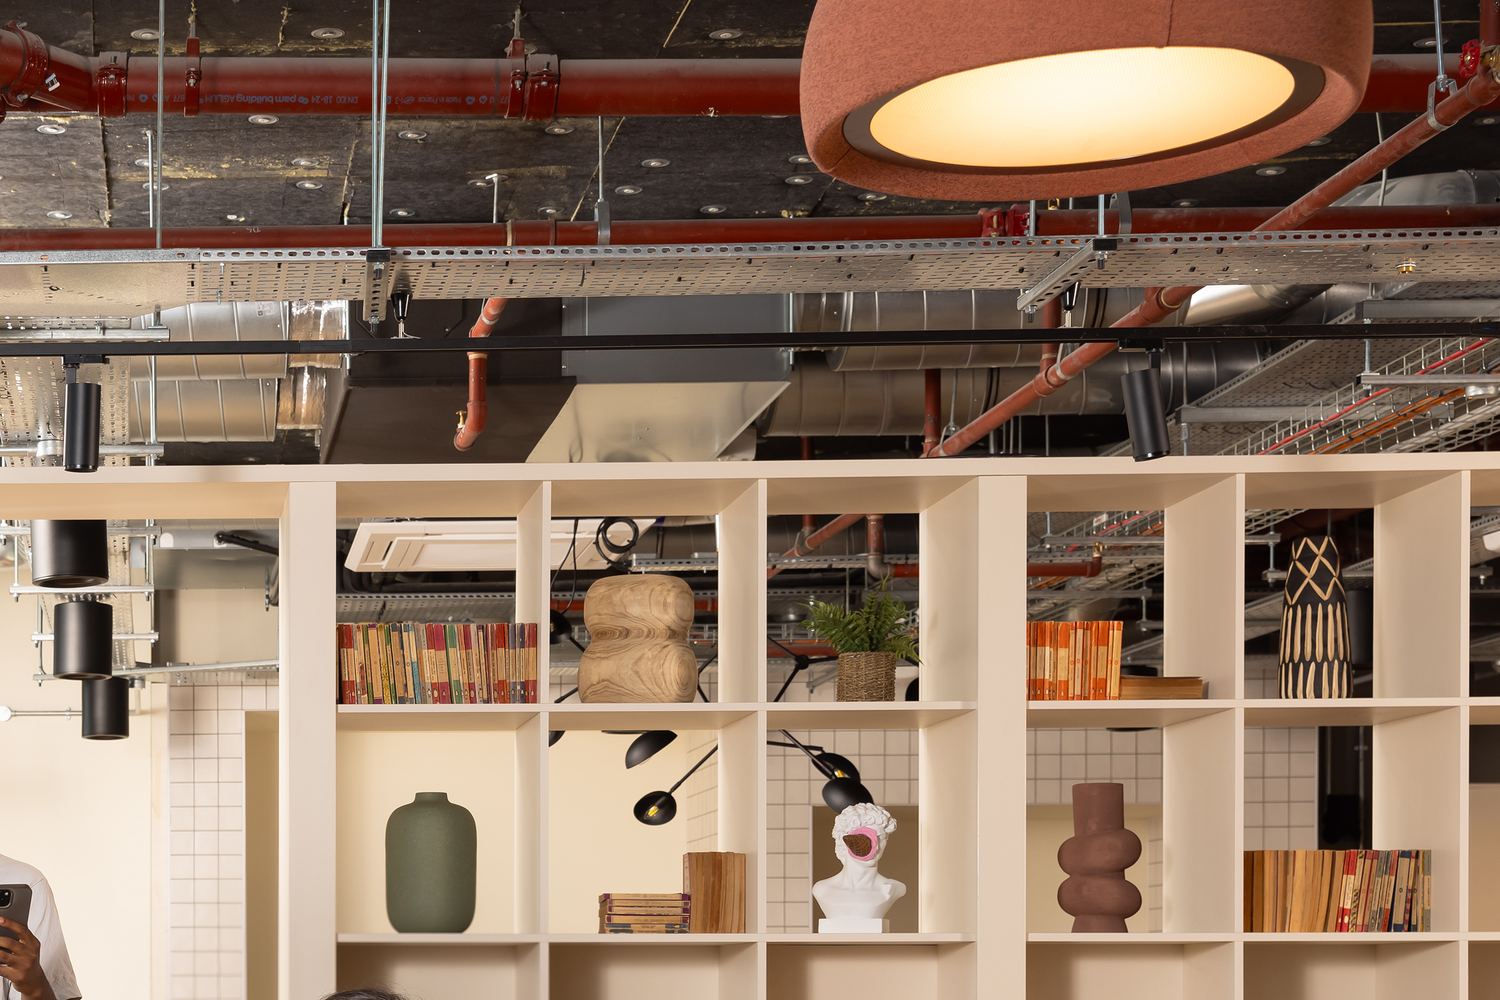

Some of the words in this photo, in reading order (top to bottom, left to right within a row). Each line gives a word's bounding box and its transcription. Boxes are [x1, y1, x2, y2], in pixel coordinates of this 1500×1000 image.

[236, 93, 274, 104] building
[275, 94, 297, 103] pam
[311, 96, 332, 104] 18-24
[418, 96, 438, 104] France
